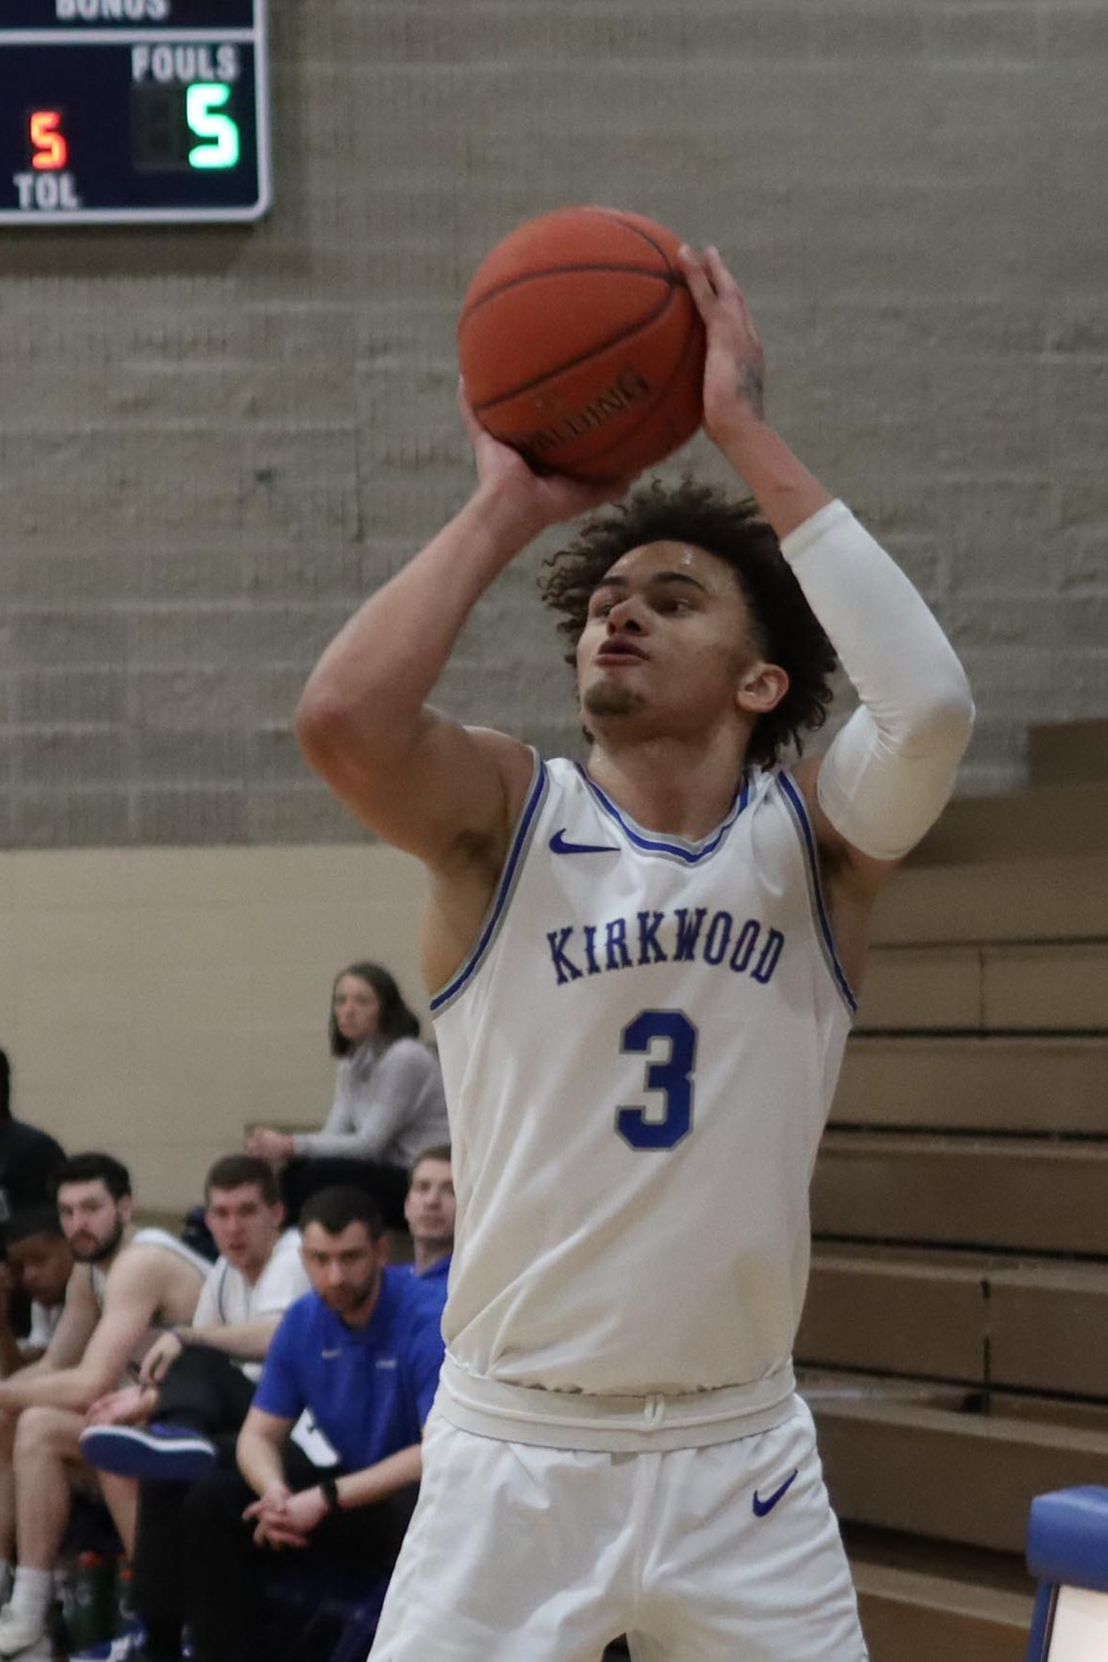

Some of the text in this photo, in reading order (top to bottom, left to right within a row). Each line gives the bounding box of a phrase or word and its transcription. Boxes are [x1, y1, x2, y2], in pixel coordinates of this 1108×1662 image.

[131, 44, 240, 83] FOULS
[30, 110, 68, 170] 5
[186, 82, 240, 169] 5
[13, 172, 80, 211] TOL
[546, 907, 785, 986] KIRKWOOD
[613, 1008, 699, 1152] 3
